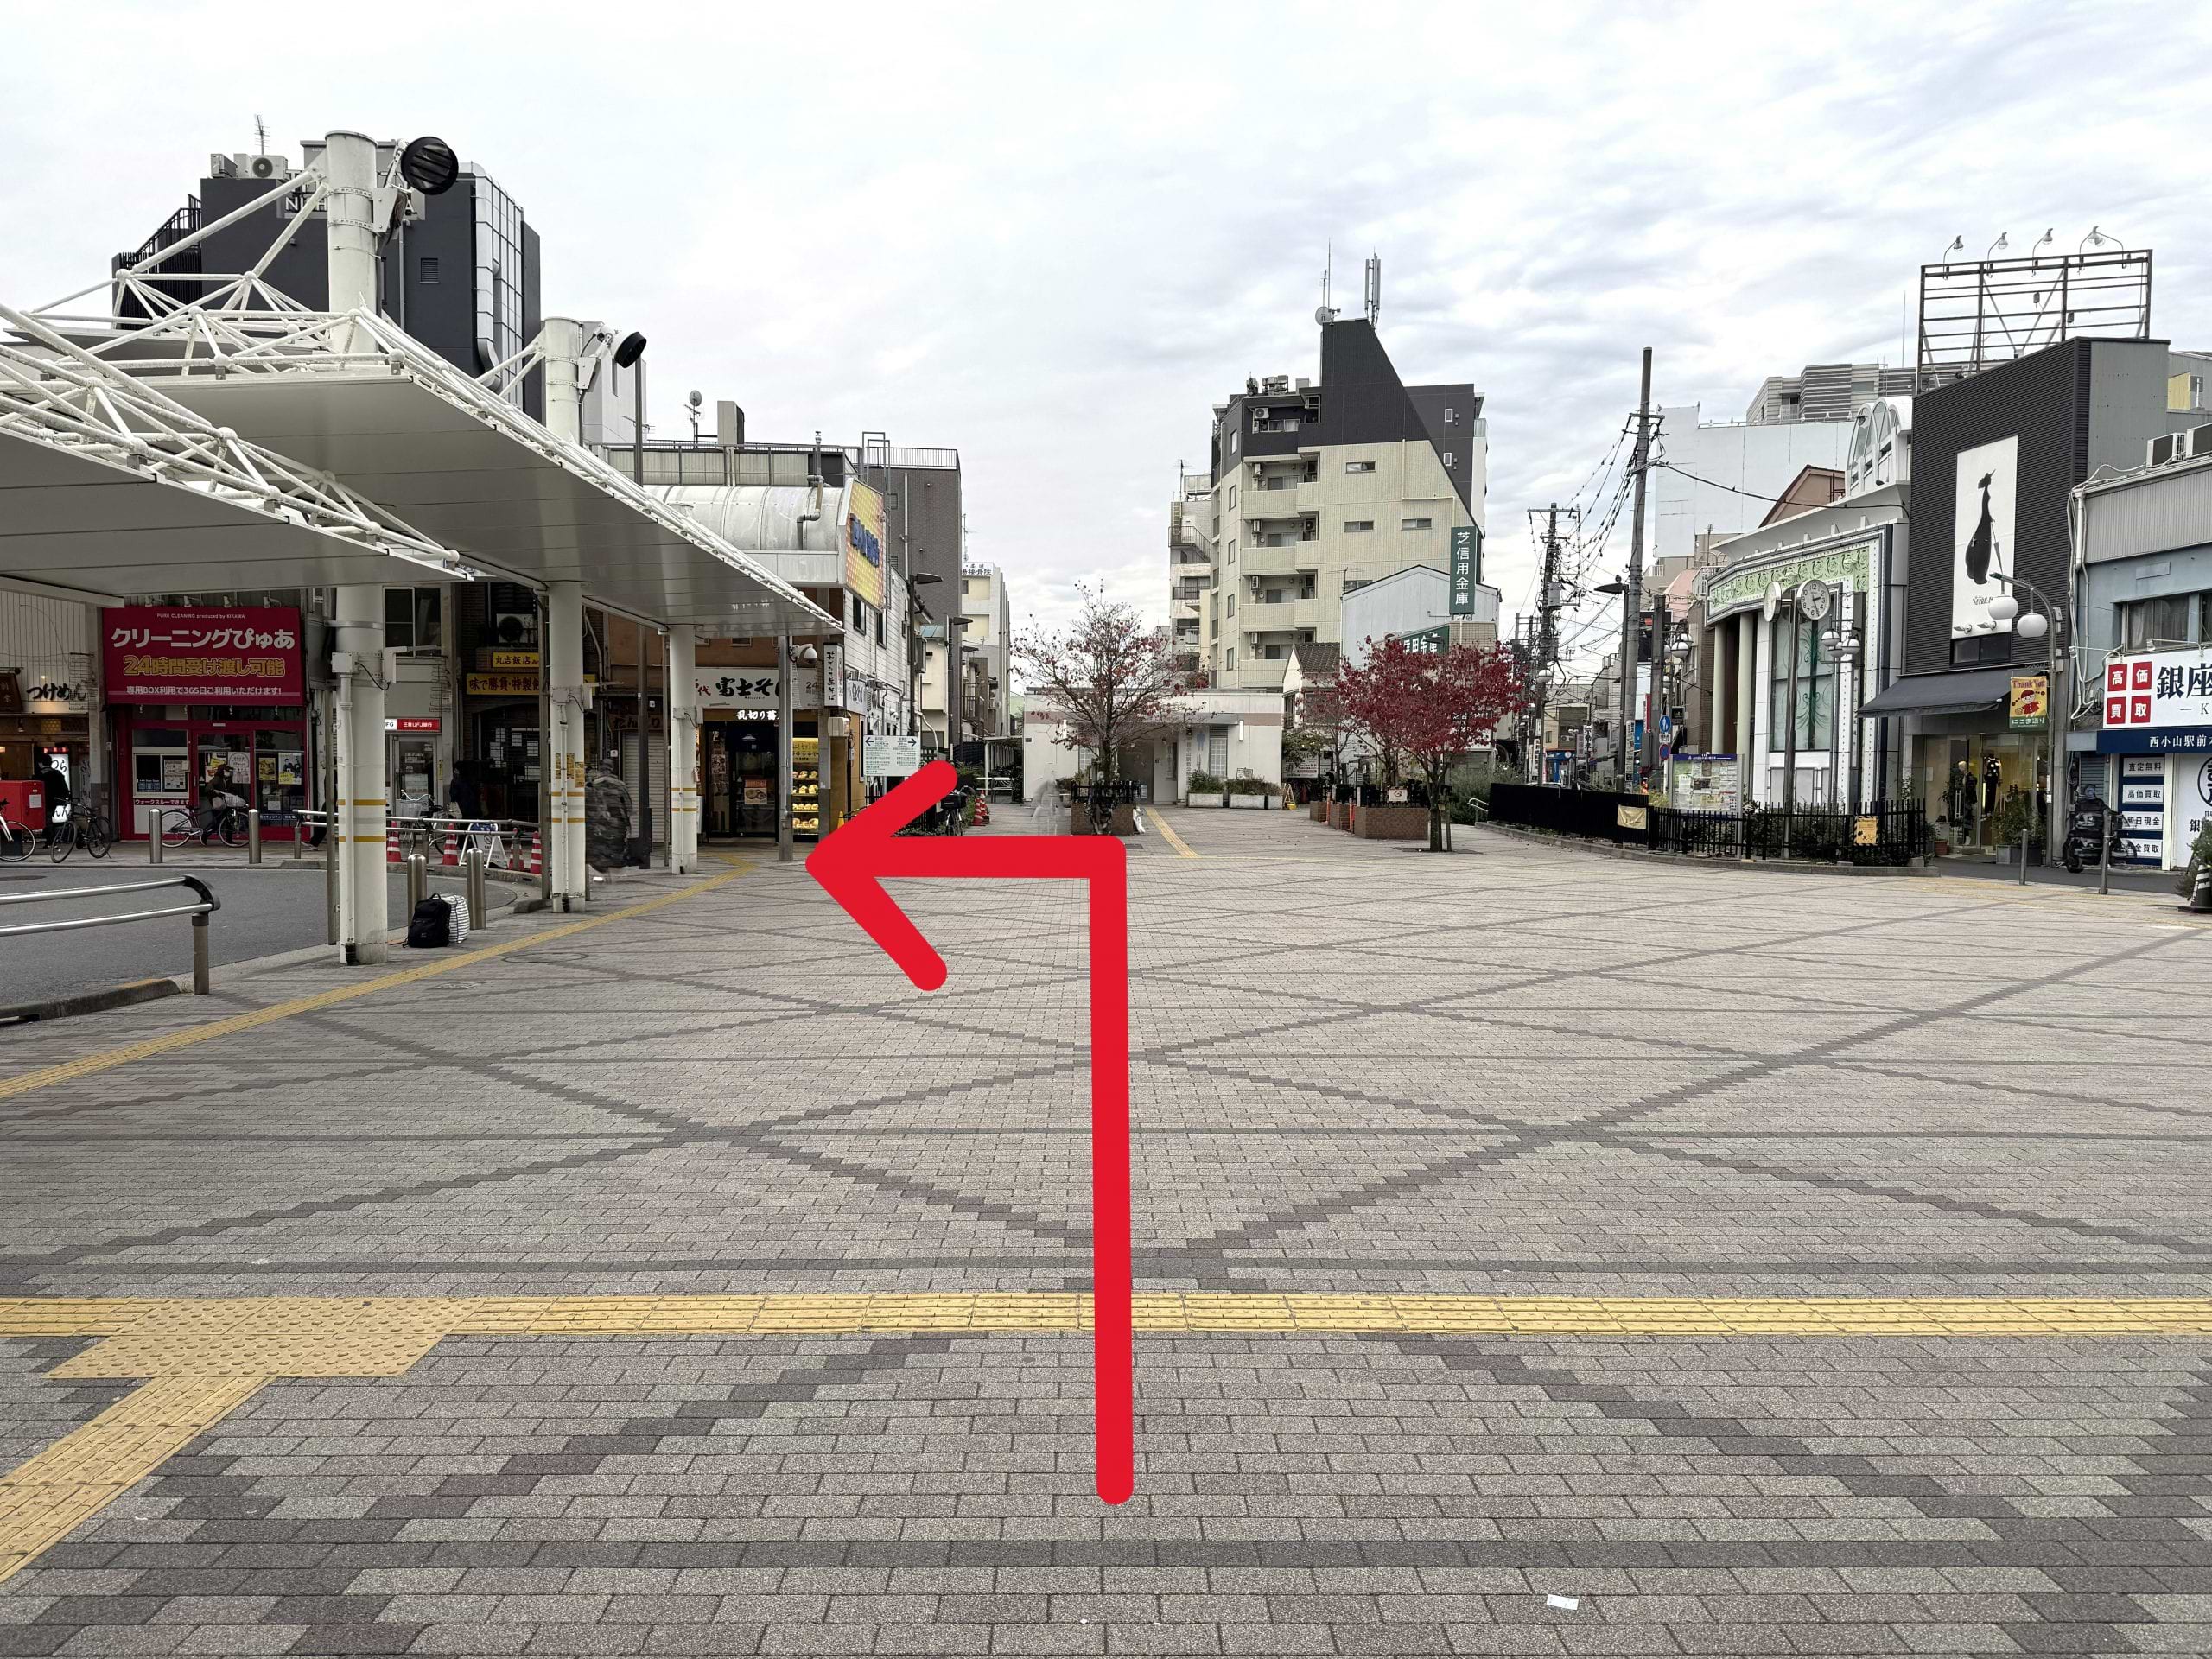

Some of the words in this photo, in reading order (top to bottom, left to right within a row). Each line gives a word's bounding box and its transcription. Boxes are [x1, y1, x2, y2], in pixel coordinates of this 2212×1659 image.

[1455, 531, 1471, 606] 芝信用金庫
[111, 627, 296, 649] クリーニングぴゅあ
[124, 655, 285, 677] 24時間受け渡し可能
[495, 655, 531, 665] 丸吉飯店
[26, 683, 86, 701] つけめん
[715, 677, 779, 697] 富士そ
[2012, 679, 2032, 689] Thank
[2128, 762, 2162, 772] 査定無料
[2127, 789, 2161, 798] 高価買取
